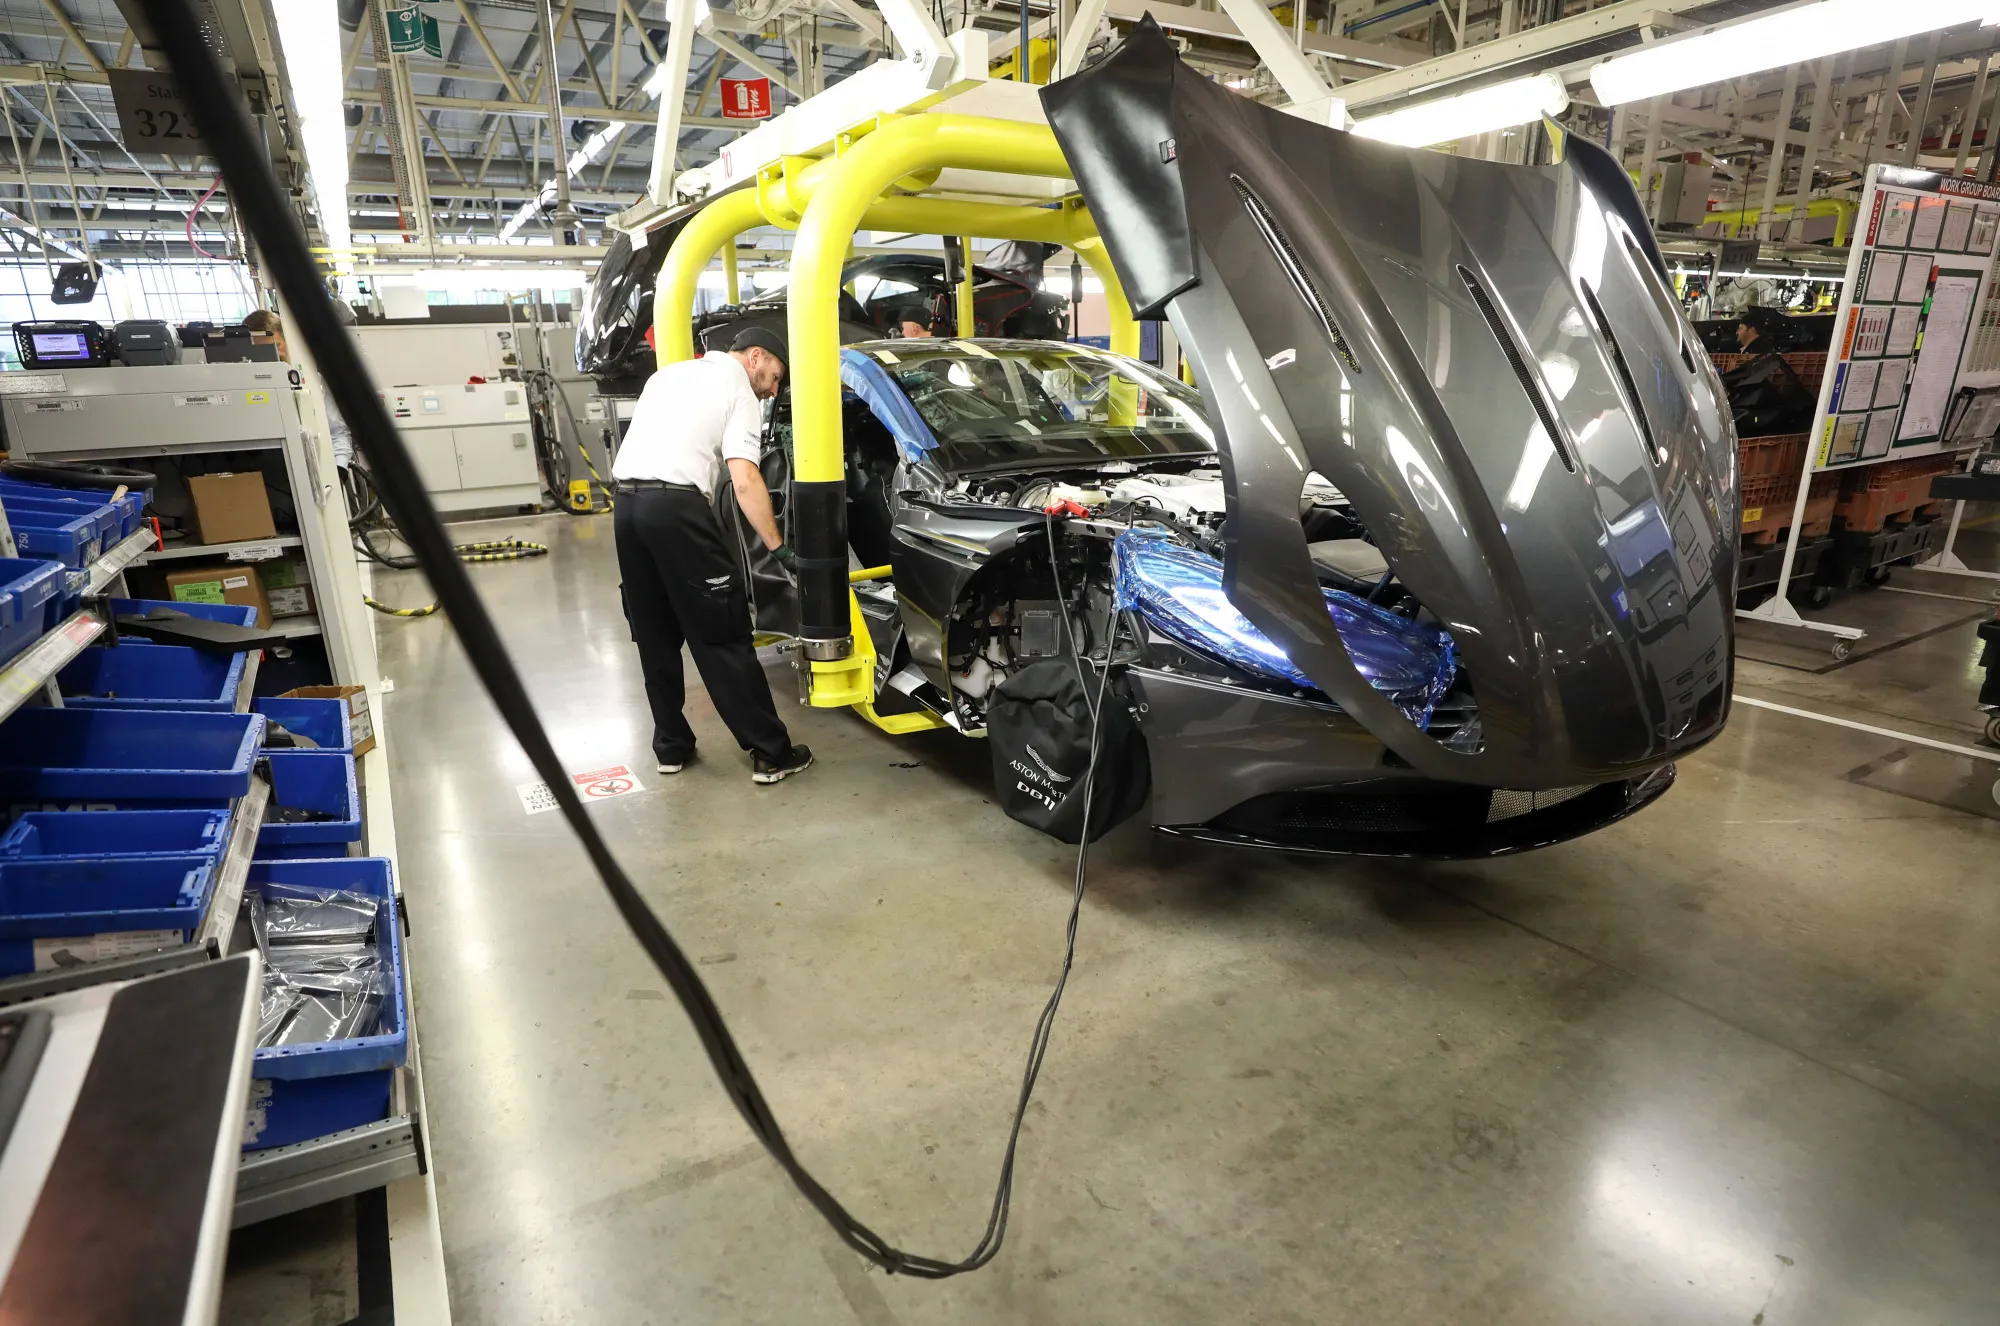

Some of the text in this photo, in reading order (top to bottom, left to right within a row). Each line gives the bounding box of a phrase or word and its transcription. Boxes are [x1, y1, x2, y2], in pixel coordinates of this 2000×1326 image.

[721, 150, 733, 180] 10
[1940, 177, 2000, 200] WORK GROUP BOAR
[1869, 198, 1882, 238] SAFETY
[1855, 256, 1869, 298] QUALITY
[1842, 311, 1856, 357] DELIVERY
[1819, 425, 1832, 460] PEOPLE
[18, 532, 29, 549] 750
[1009, 759, 1040, 782] ASTON
[1016, 780, 1056, 811] DB11
